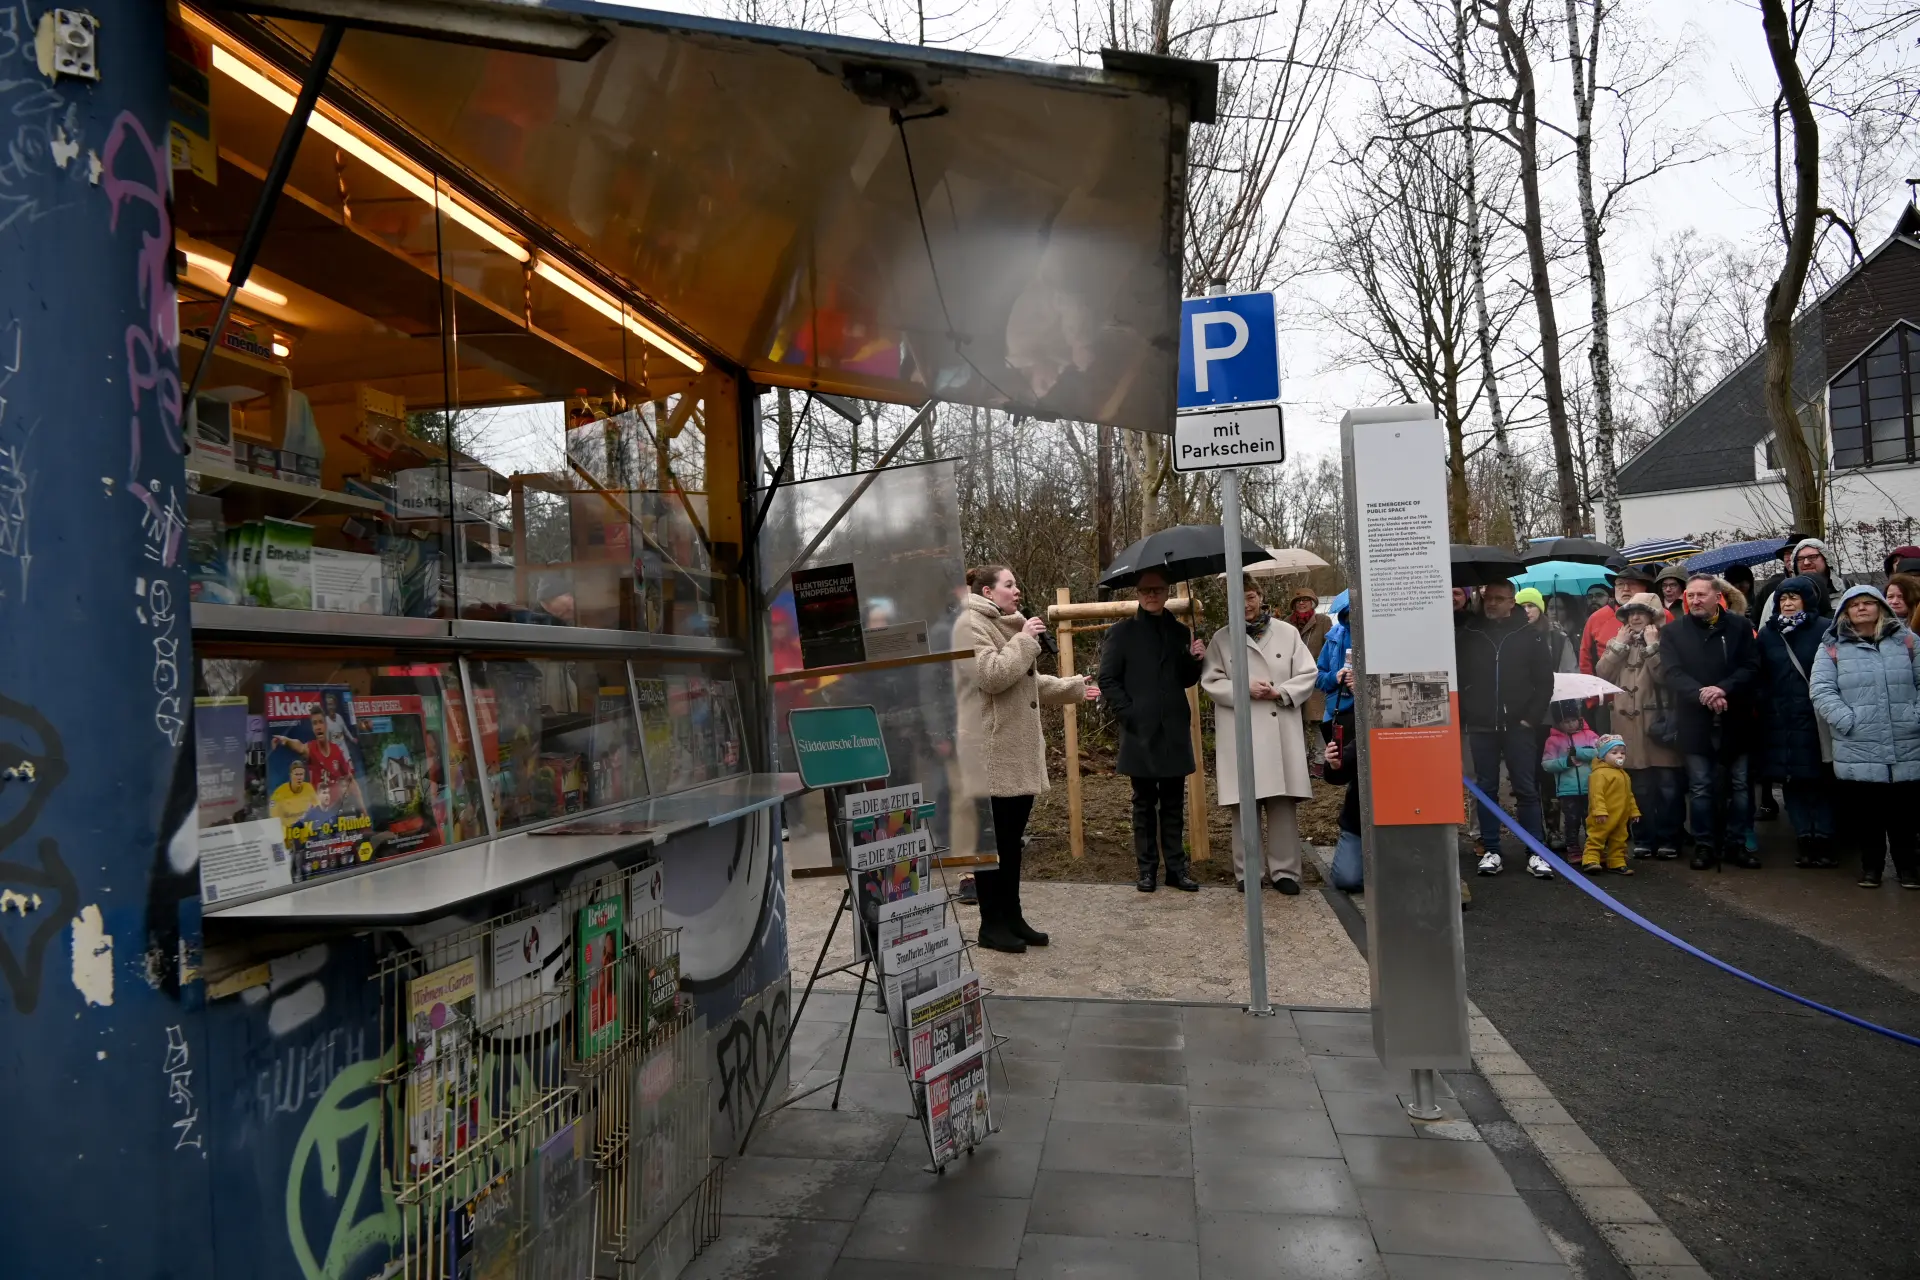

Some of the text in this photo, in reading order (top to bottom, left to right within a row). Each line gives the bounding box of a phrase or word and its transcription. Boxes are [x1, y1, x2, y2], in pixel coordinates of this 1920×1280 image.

[227, 334, 271, 358] mentos
[1191, 310, 1250, 393] P
[1213, 421, 1241, 438] mit
[1182, 438, 1275, 459] Parkschein
[795, 575, 854, 591] ELEKTRISCH AUF
[800, 585, 852, 599] KNOPFDRUCK.
[275, 695, 321, 717] kicke
[370, 700, 403, 712] SPIEGEL
[798, 734, 881, 753] Süddeutsche Zeitung
[862, 798, 880, 814] DIE
[890, 792, 910, 809] ZEIT
[305, 831, 364, 849] Champions League
[305, 849, 328, 860] Europa
[328, 845, 353, 856] League
[868, 840, 917, 865] DIE ZEIT
[923, 936, 949, 958] Allgemeine
[448, 973, 474, 992] Garten
[652, 967, 676, 990] TRAUM-
[652, 981, 676, 1004] GARTEN
[933, 1027, 948, 1046] Das
[914, 1033, 932, 1070] Bild
[933, 1041, 956, 1065] letzte
[960, 1074, 972, 1092] traf
[972, 1067, 984, 1085] den
